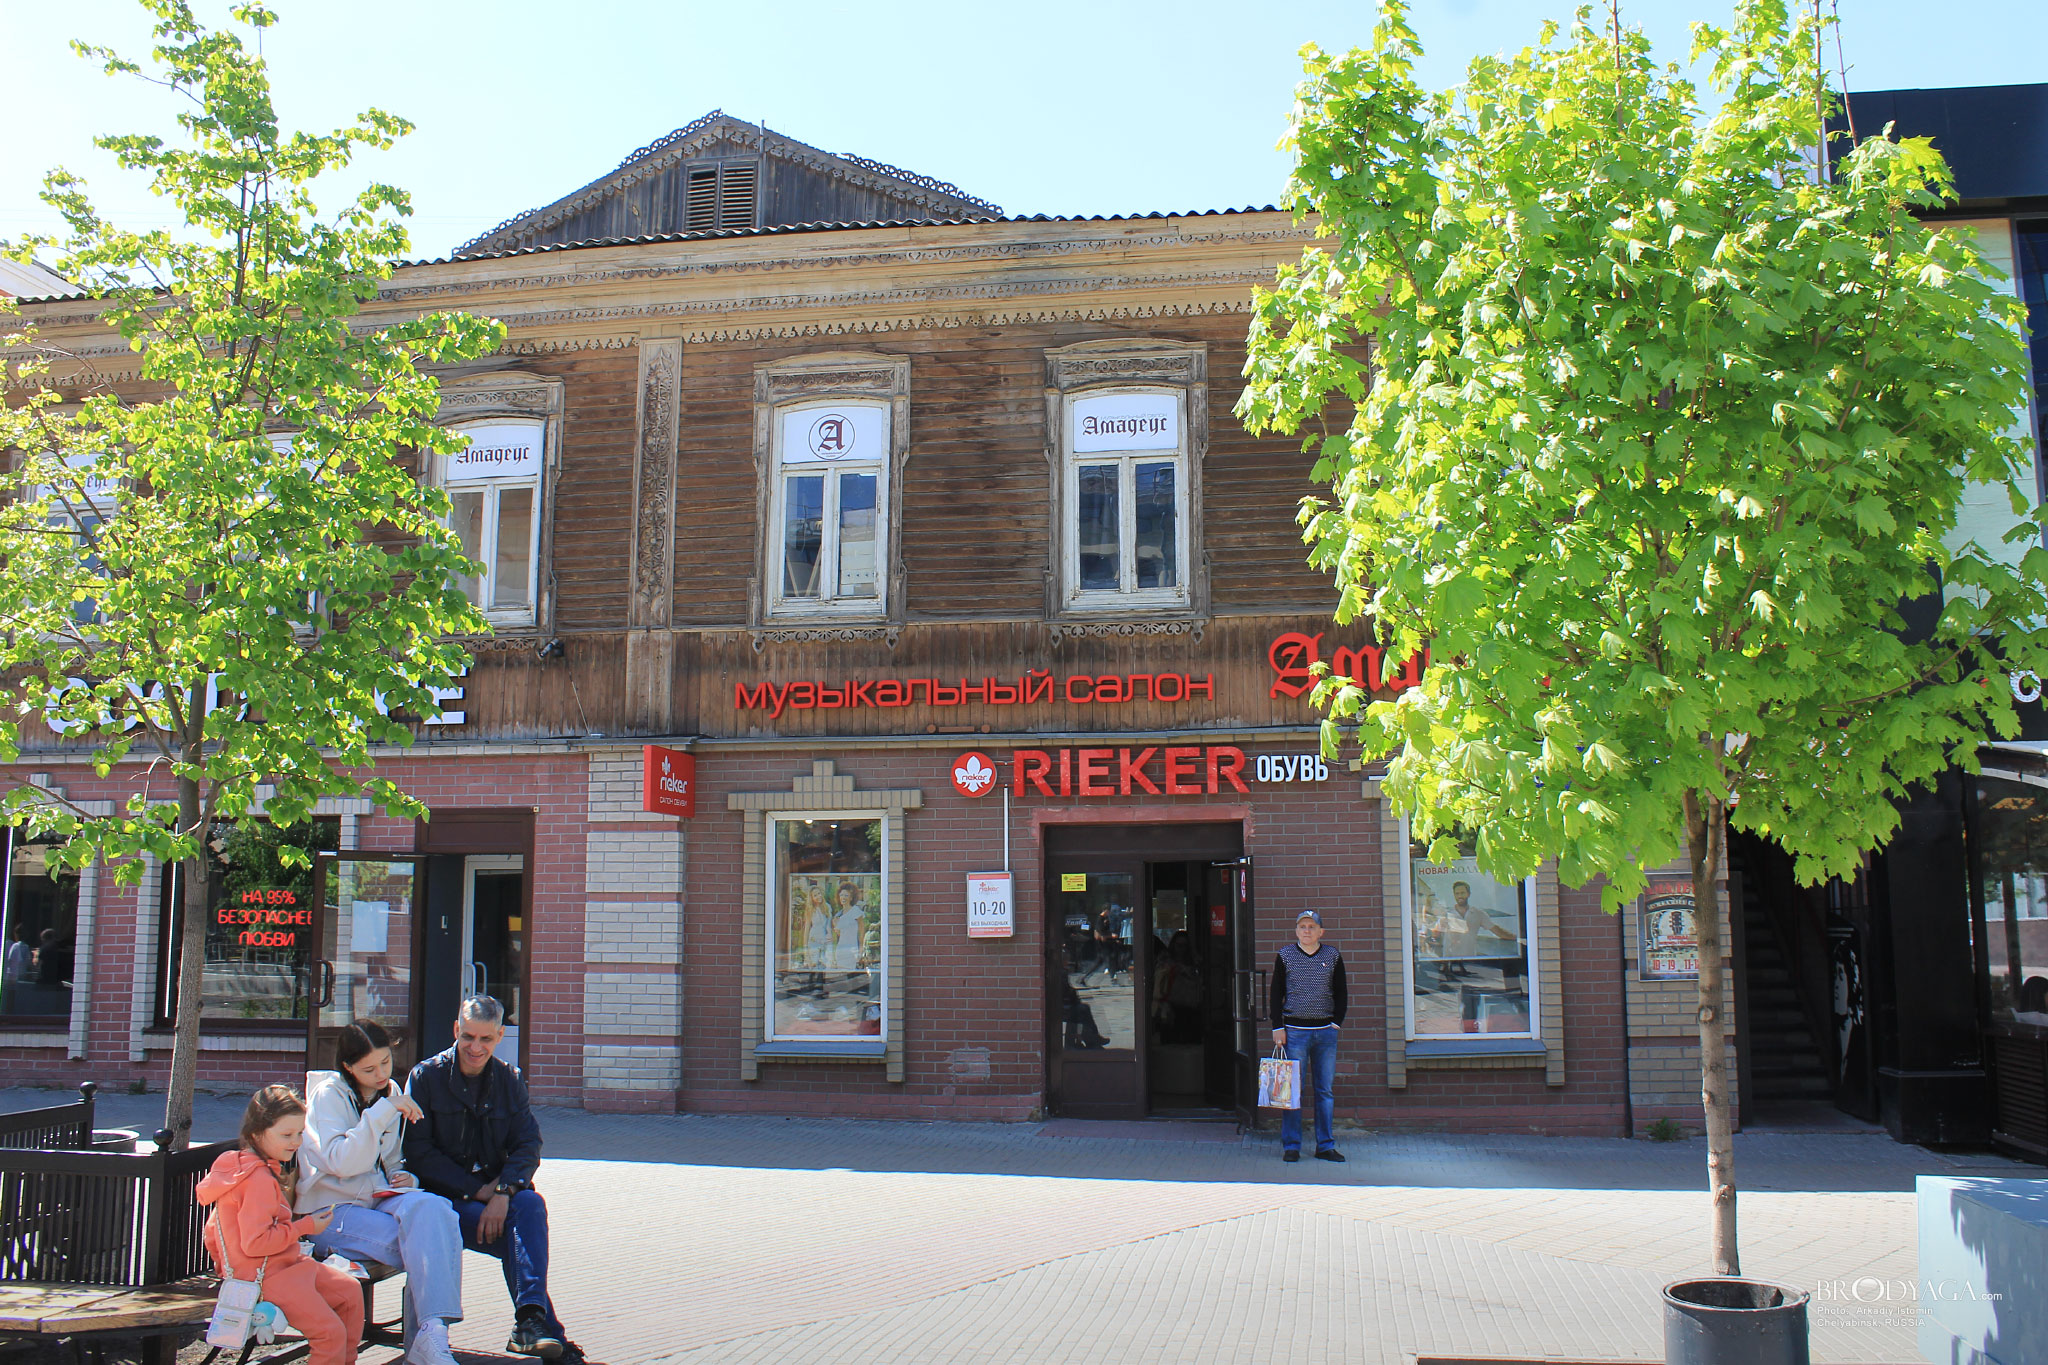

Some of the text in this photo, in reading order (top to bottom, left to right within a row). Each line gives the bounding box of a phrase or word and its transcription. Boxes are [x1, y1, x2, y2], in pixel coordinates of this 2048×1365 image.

[734, 668, 1214, 719] музыкальный салон
[1013, 746, 1251, 797] RIEKER
[1257, 754, 1329, 782] ОБУВЬ
[660, 772, 688, 793] rieker
[1418, 866, 1449, 875] НОВАЯ
[242, 890, 296, 905] НА 95%
[973, 901, 1006, 916] 10-20
[238, 931, 295, 947] ЛЮБВИ
